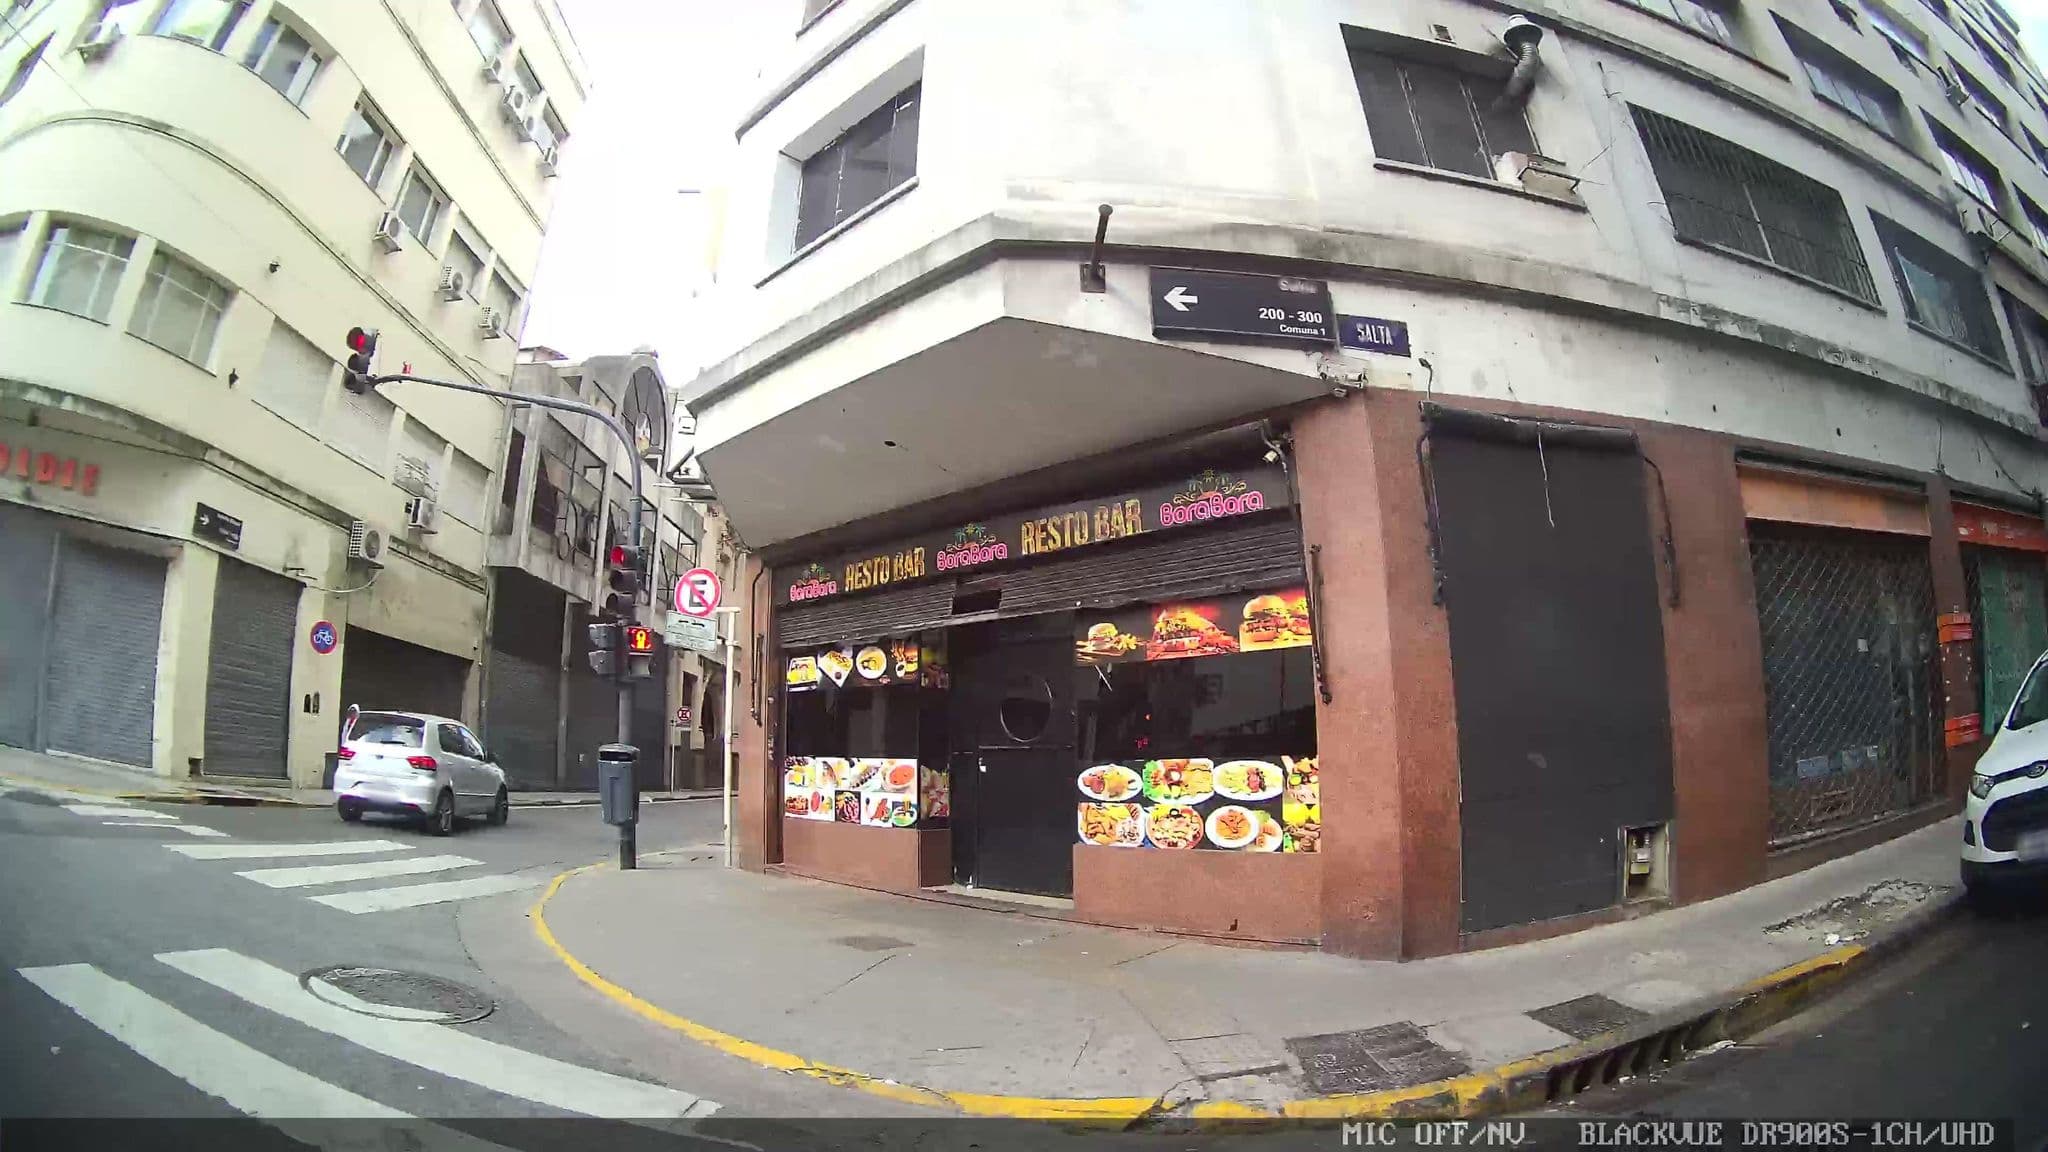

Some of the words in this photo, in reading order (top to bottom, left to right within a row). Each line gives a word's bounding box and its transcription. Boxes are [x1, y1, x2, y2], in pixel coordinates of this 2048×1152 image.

[1259, 307, 1285, 320] 200
[1297, 310, 1323, 324] 300
[1279, 324, 1318, 335] Comuna
[1320, 328, 1326, 336] 1
[1356, 323, 1393, 346] SALTA
[1021, 510, 1088, 556] RESTO
[1093, 499, 1143, 542] BAR
[845, 554, 890, 592] RESTO
[893, 547, 926, 582] BAR
